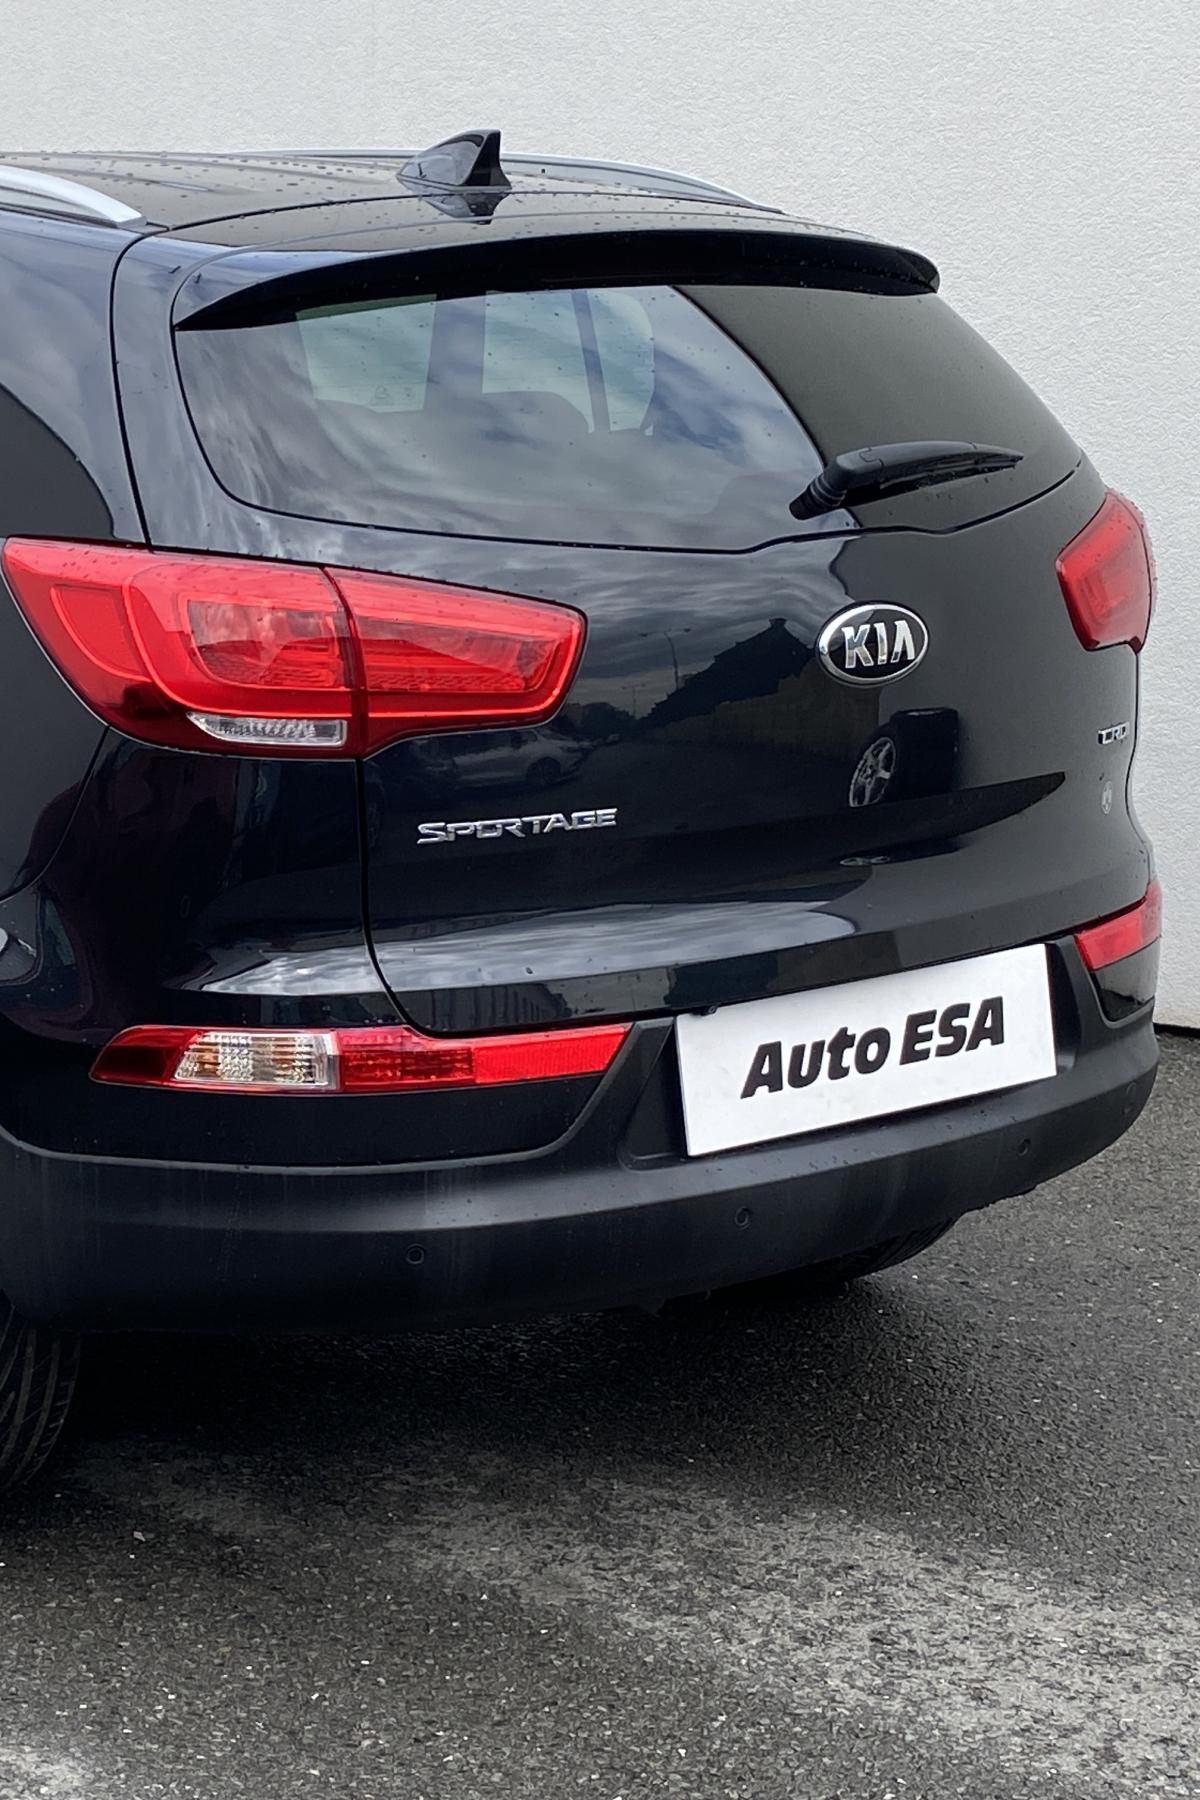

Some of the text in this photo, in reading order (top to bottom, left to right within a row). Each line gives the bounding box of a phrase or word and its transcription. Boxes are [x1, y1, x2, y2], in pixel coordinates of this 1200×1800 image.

[841, 620, 915, 669] KIA
[417, 808, 618, 845] SPORTAGE
[740, 996, 1005, 1099] Auto ESA
